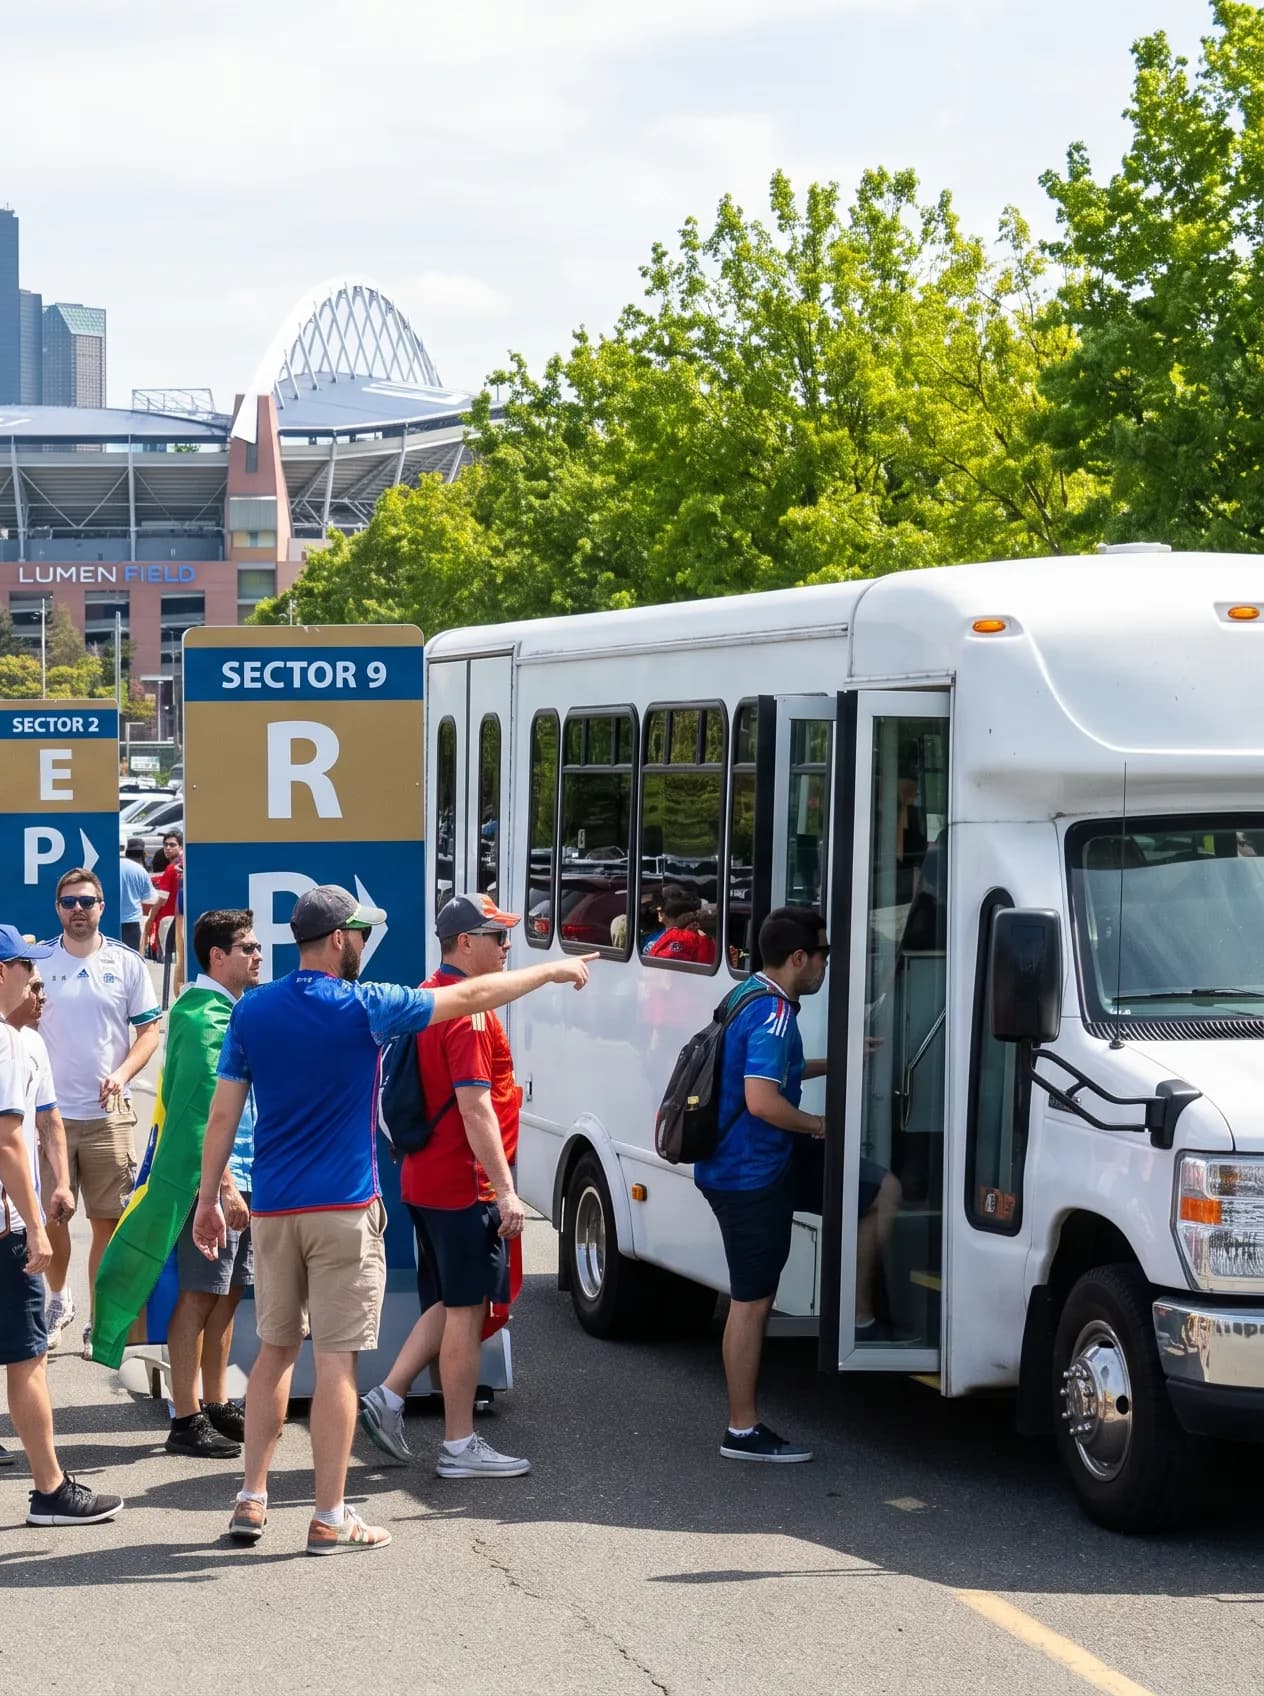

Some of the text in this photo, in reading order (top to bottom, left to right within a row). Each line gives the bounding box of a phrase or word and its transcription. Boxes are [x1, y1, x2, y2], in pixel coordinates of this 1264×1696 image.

[19, 565, 196, 584] LUMEN FIELD
[221, 661, 387, 689] SECTOR 9
[12, 717, 99, 732] SECTOR 2
[39, 749, 73, 800] E
[267, 720, 343, 819] R
[24, 826, 66, 885] P
[248, 871, 319, 984] P
